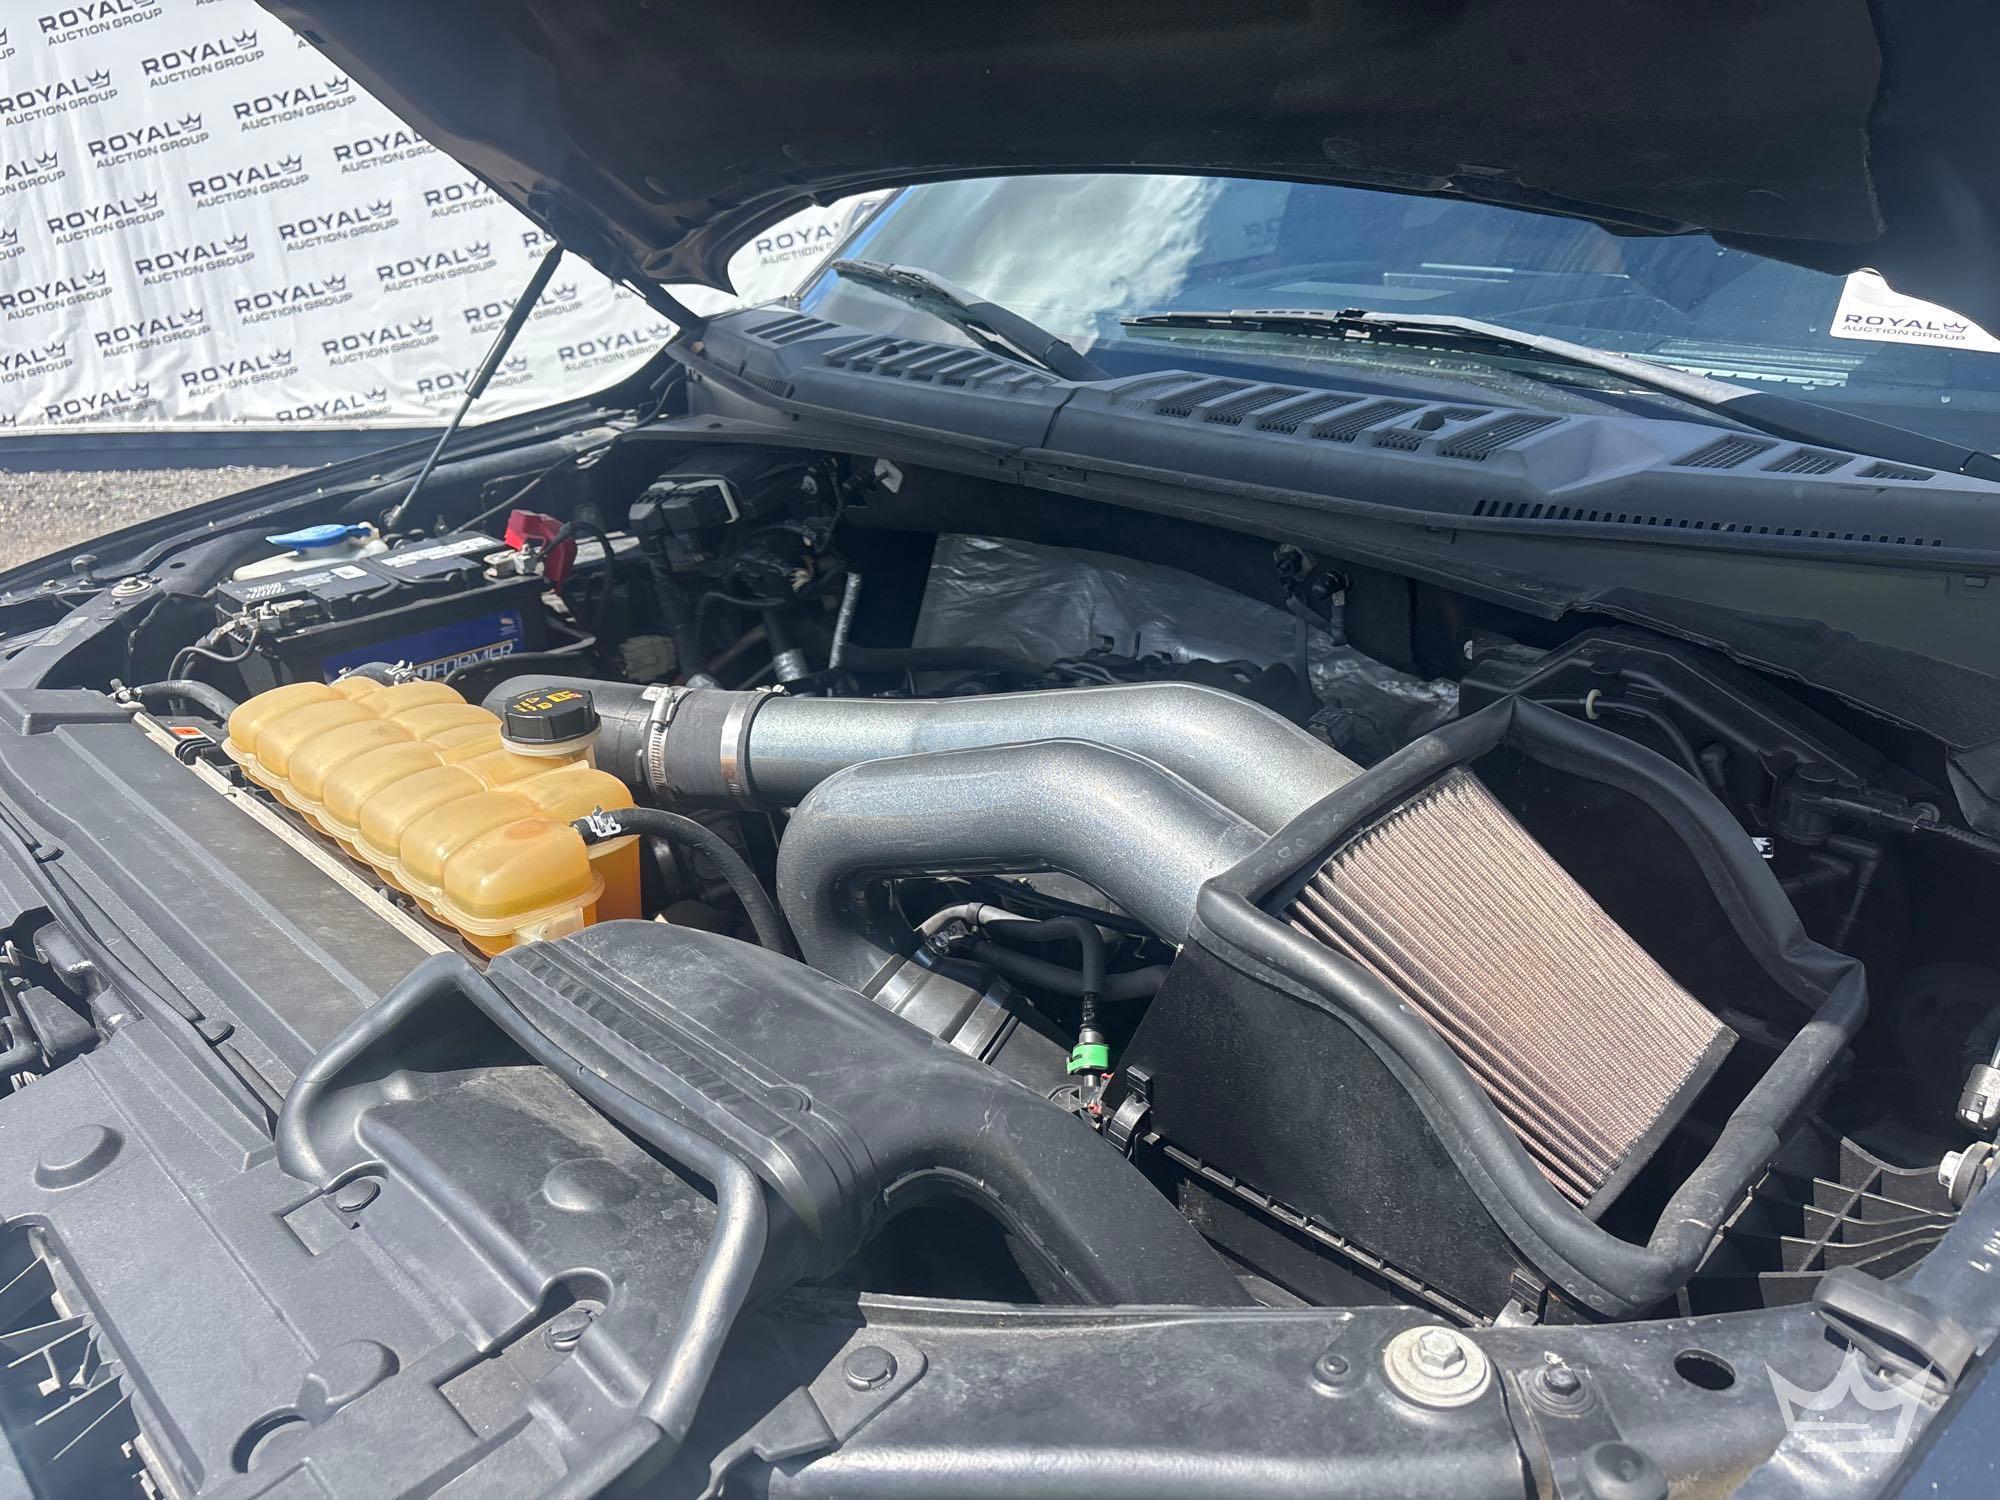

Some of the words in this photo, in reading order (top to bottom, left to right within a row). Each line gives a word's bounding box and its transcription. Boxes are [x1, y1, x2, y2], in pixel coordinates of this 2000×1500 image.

[38, 0, 133, 33] ROYAL
[48, 22, 110, 46] AUCTION
[112, 8, 162, 29] GROUP
[141, 39, 236, 75] ROYAL
[150, 64, 213, 88] AUCTION
[214, 50, 264, 71] GROUP
[0, 79, 88, 114] ROYAL
[6, 103, 67, 126] AUCTION
[69, 89, 118, 110] GROUP
[233, 85, 327, 119] ROYAL
[241, 109, 303, 132] AUCTION
[305, 95, 357, 116] GROUP
[88, 122, 180, 157] ROYAL
[97, 145, 158, 169] AUCTION
[160, 132, 209, 152] GROUP
[341, 151, 404, 174] AUCTION
[18, 170, 66, 190] GROUP
[188, 163, 280, 197] ROYAL
[196, 185, 258, 209] AUCTION
[260, 174, 309, 194] GROUP
[424, 180, 489, 206] ROY
[47, 200, 137, 233] ROYAL
[431, 196, 494, 218] AUCTION
[56, 224, 113, 245] AUCTION
[115, 209, 165, 230] GROUP
[278, 208, 370, 240] ROYAL
[286, 231, 348, 252] AUCTION
[350, 217, 400, 238] GROUP
[756, 222, 839, 254] ROYA
[135, 242, 227, 274] ROYAL
[143, 261, 204, 286] AUCTION
[205, 252, 255, 271] GROUP
[377, 249, 468, 281] ROYAL
[383, 271, 445, 293] AUCTION
[447, 259, 497, 279] GROUP
[0, 278, 87, 310] ROYAL
[8, 300, 65, 321] AUCTION
[67, 287, 113, 306] GROUP
[234, 283, 325, 313] ROYAL
[242, 304, 302, 325] AUCTION
[303, 292, 353, 311] GROUP
[533, 302, 583, 320] GROUP
[1844, 314, 1940, 331] ROYAL
[95, 316, 184, 347] ROYAL
[103, 338, 160, 358] AUCTION
[162, 325, 211, 344] GROUP
[322, 325, 411, 355] ROYAL
[558, 330, 648, 361] ROYAL
[1842, 325, 1911, 336] AUCTION
[1912, 331, 1966, 341] GROUP
[329, 346, 389, 367] AUCTION
[391, 333, 439, 353] GROUP
[564, 350, 625, 372] AUCTION
[27, 359, 73, 378] GROUP
[181, 356, 270, 387] ROYAL
[251, 366, 299, 384] GROUP
[45, 389, 131, 418] ROYAL
